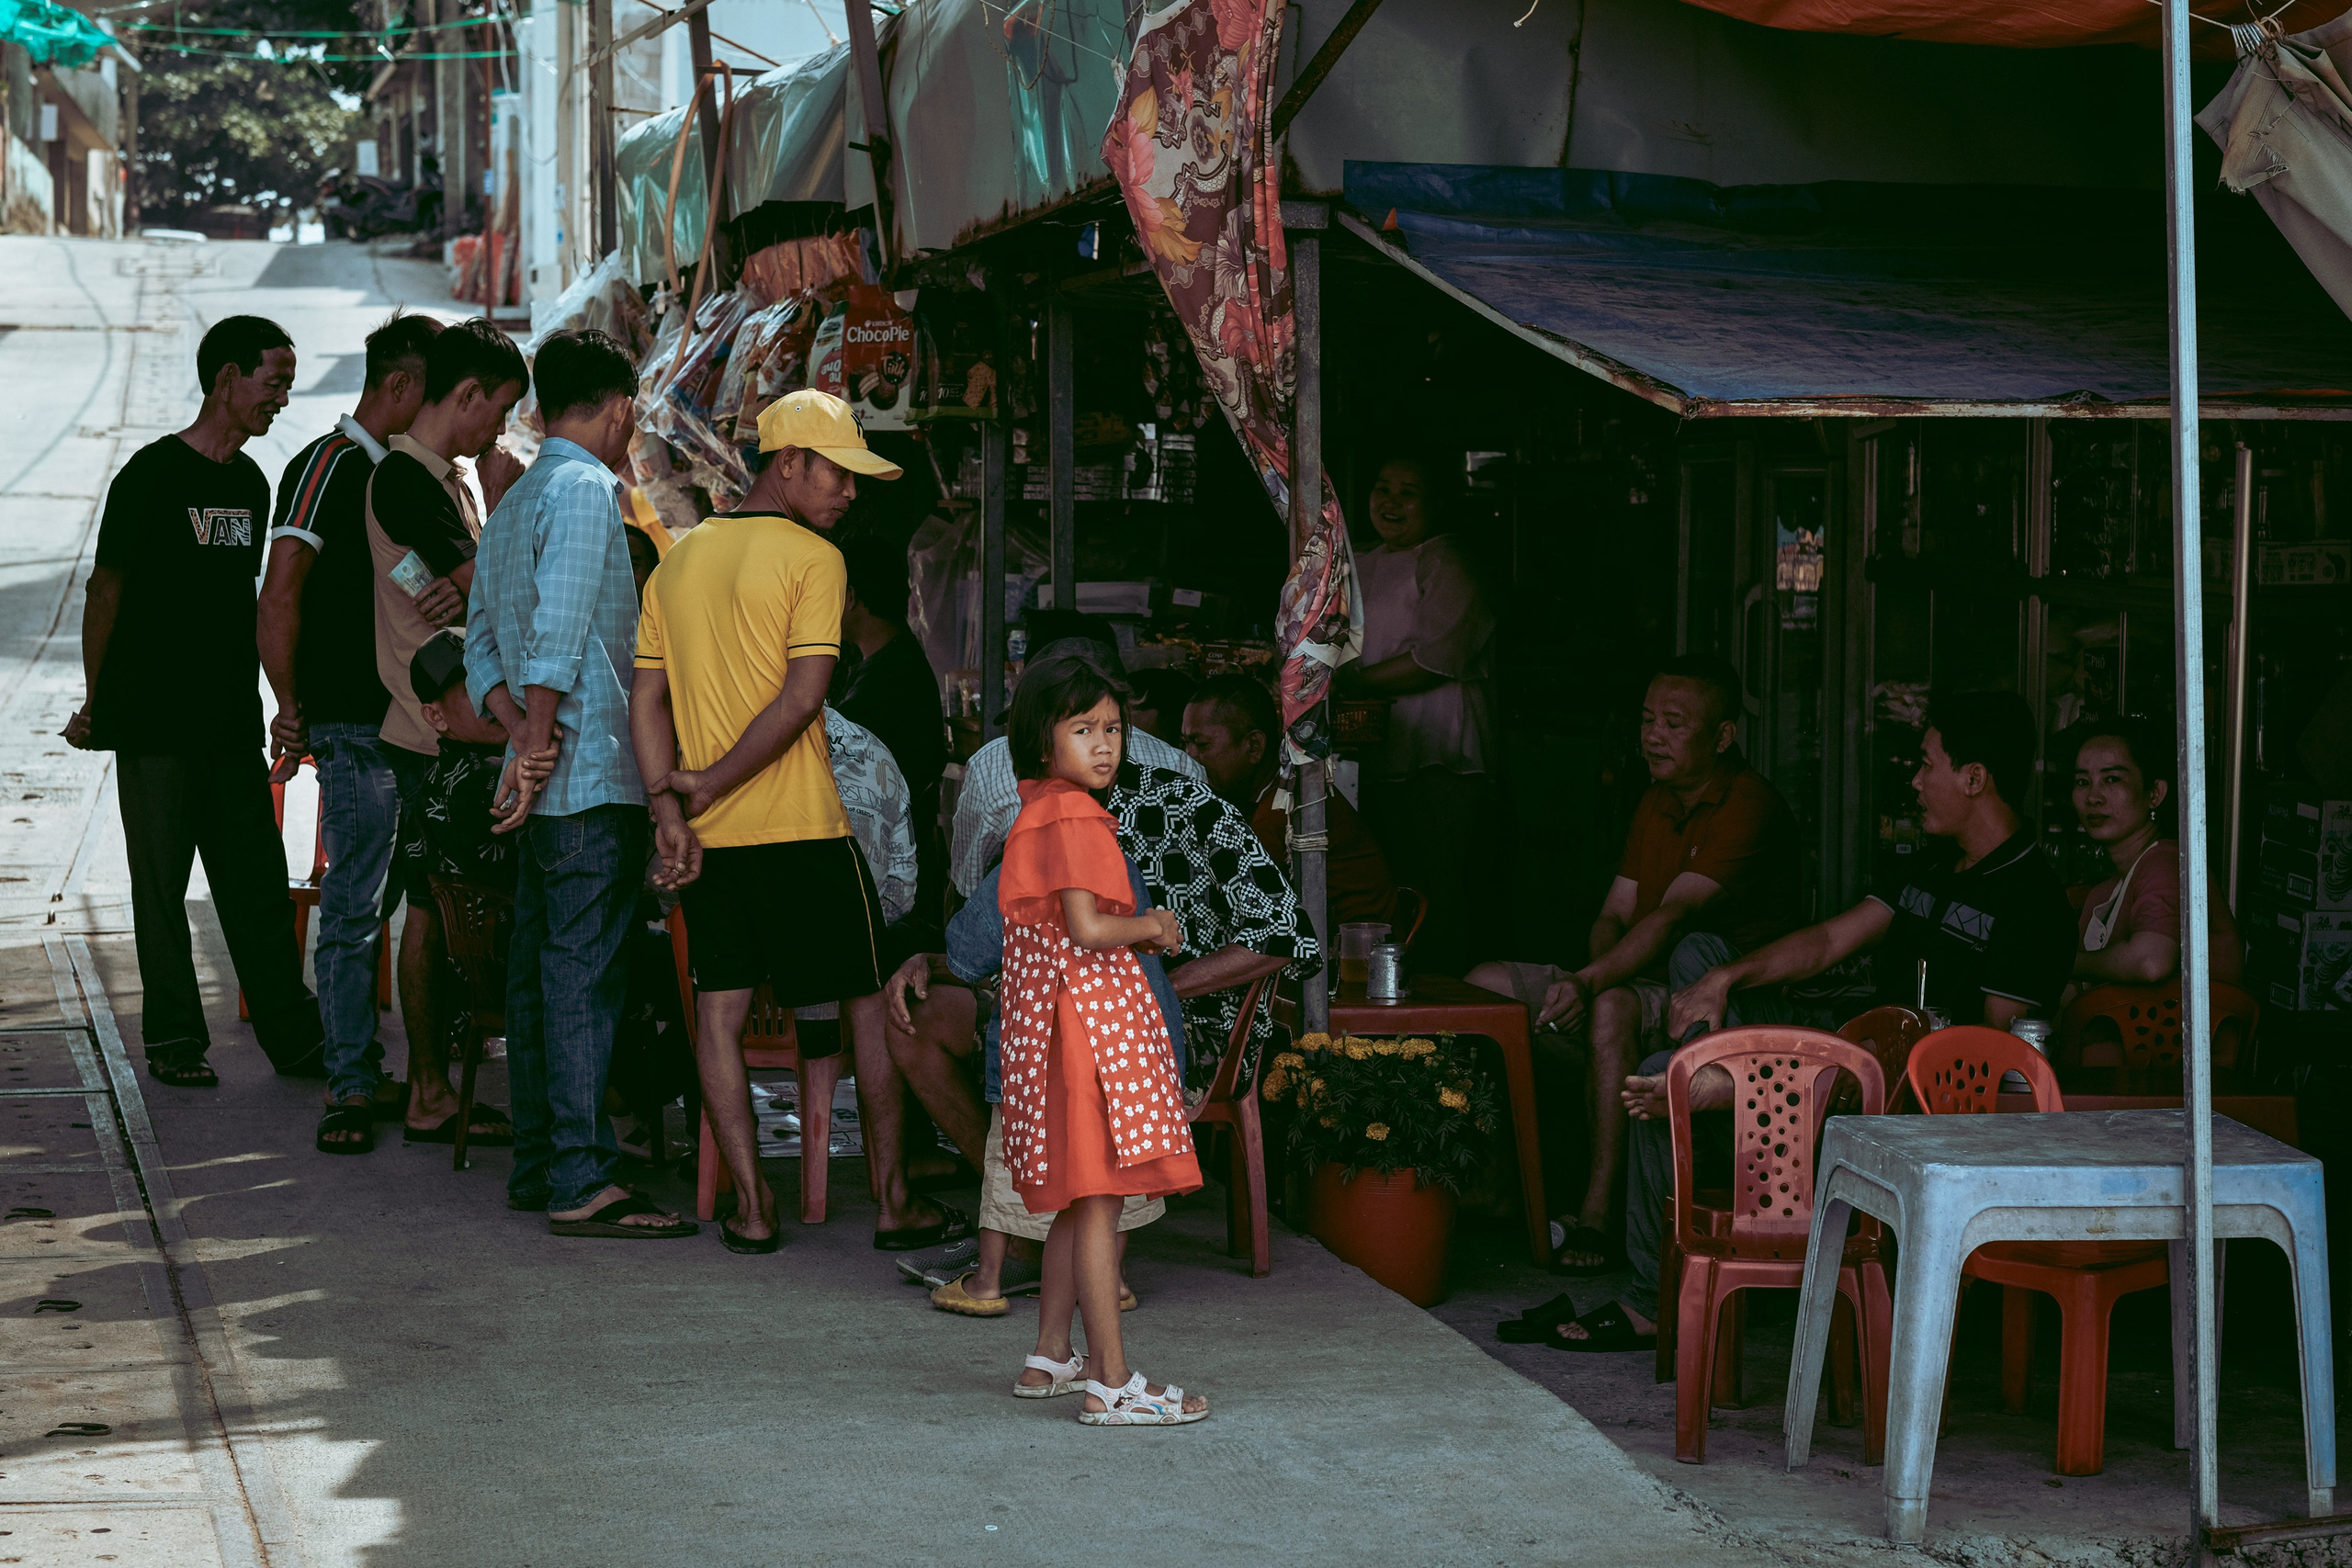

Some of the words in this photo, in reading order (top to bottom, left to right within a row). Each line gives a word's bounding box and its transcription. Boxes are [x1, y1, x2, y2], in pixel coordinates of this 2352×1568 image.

[846, 325, 910, 343] ChocoPie
[937, 387, 950, 400] 10
[187, 507, 253, 547] VAN
